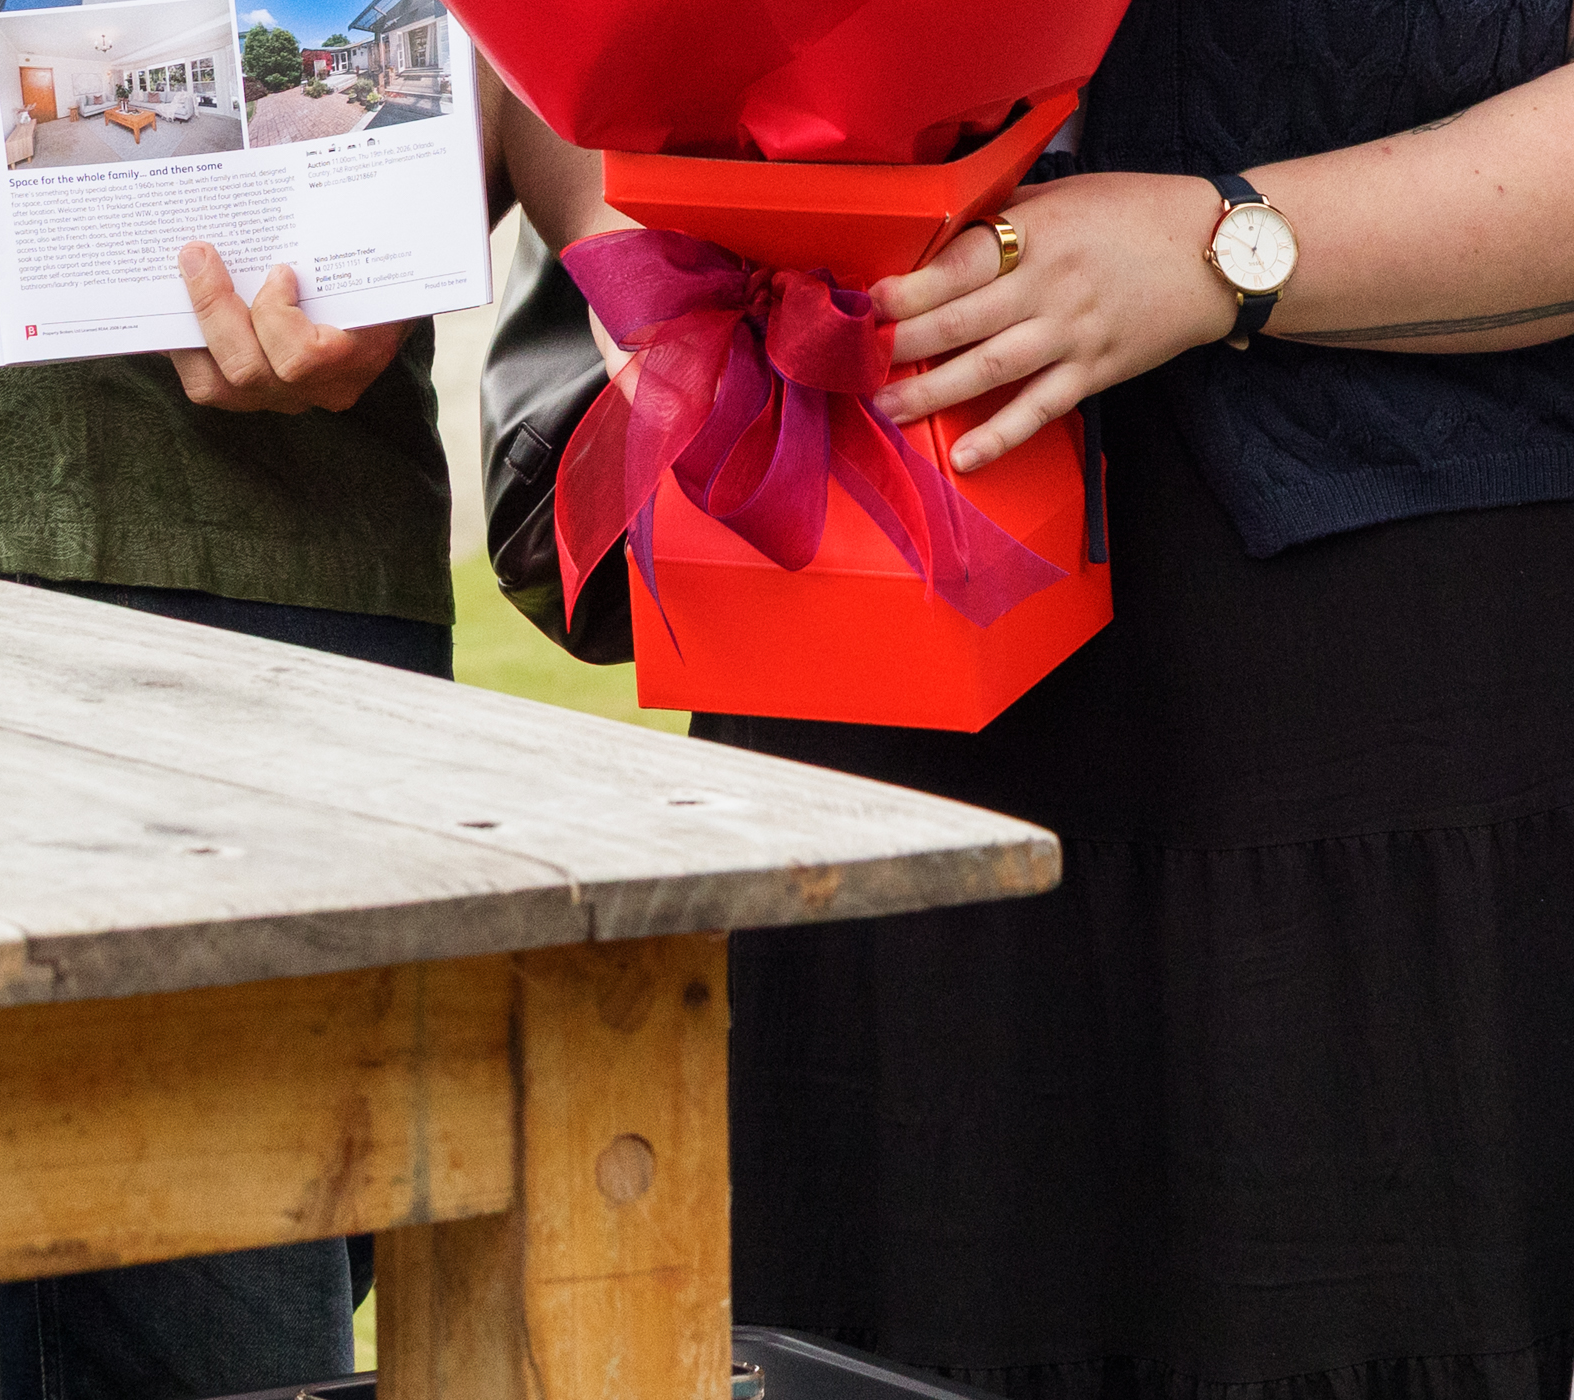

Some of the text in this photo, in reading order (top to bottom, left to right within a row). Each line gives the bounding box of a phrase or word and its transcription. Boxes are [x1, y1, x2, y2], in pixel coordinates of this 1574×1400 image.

[307, 161, 330, 169] Auction
[413, 142, 434, 150] Orlando
[9, 163, 223, 189] Space for the whole family... and then some
[85, 186, 107, 194] special
[239, 171, 257, 179] mind,
[258, 167, 286, 177] designed
[43, 198, 70, 206] comfort,
[85, 195, 113, 203] everyday
[219, 182, 241, 191] special
[274, 176, 294, 184] sought
[135, 200, 162, 208] Crescent
[185, 196, 202, 205] you'll
[232, 190, 262, 200] generous
[263, 186, 294, 195] bedrooms,
[160, 208, 190, 217] gorgeous
[248, 198, 269, 206] French
[330, 248, 375, 261] Johnston-Treder
[332, 272, 352, 280] Ensing
[28, 327, 35, 336] B
